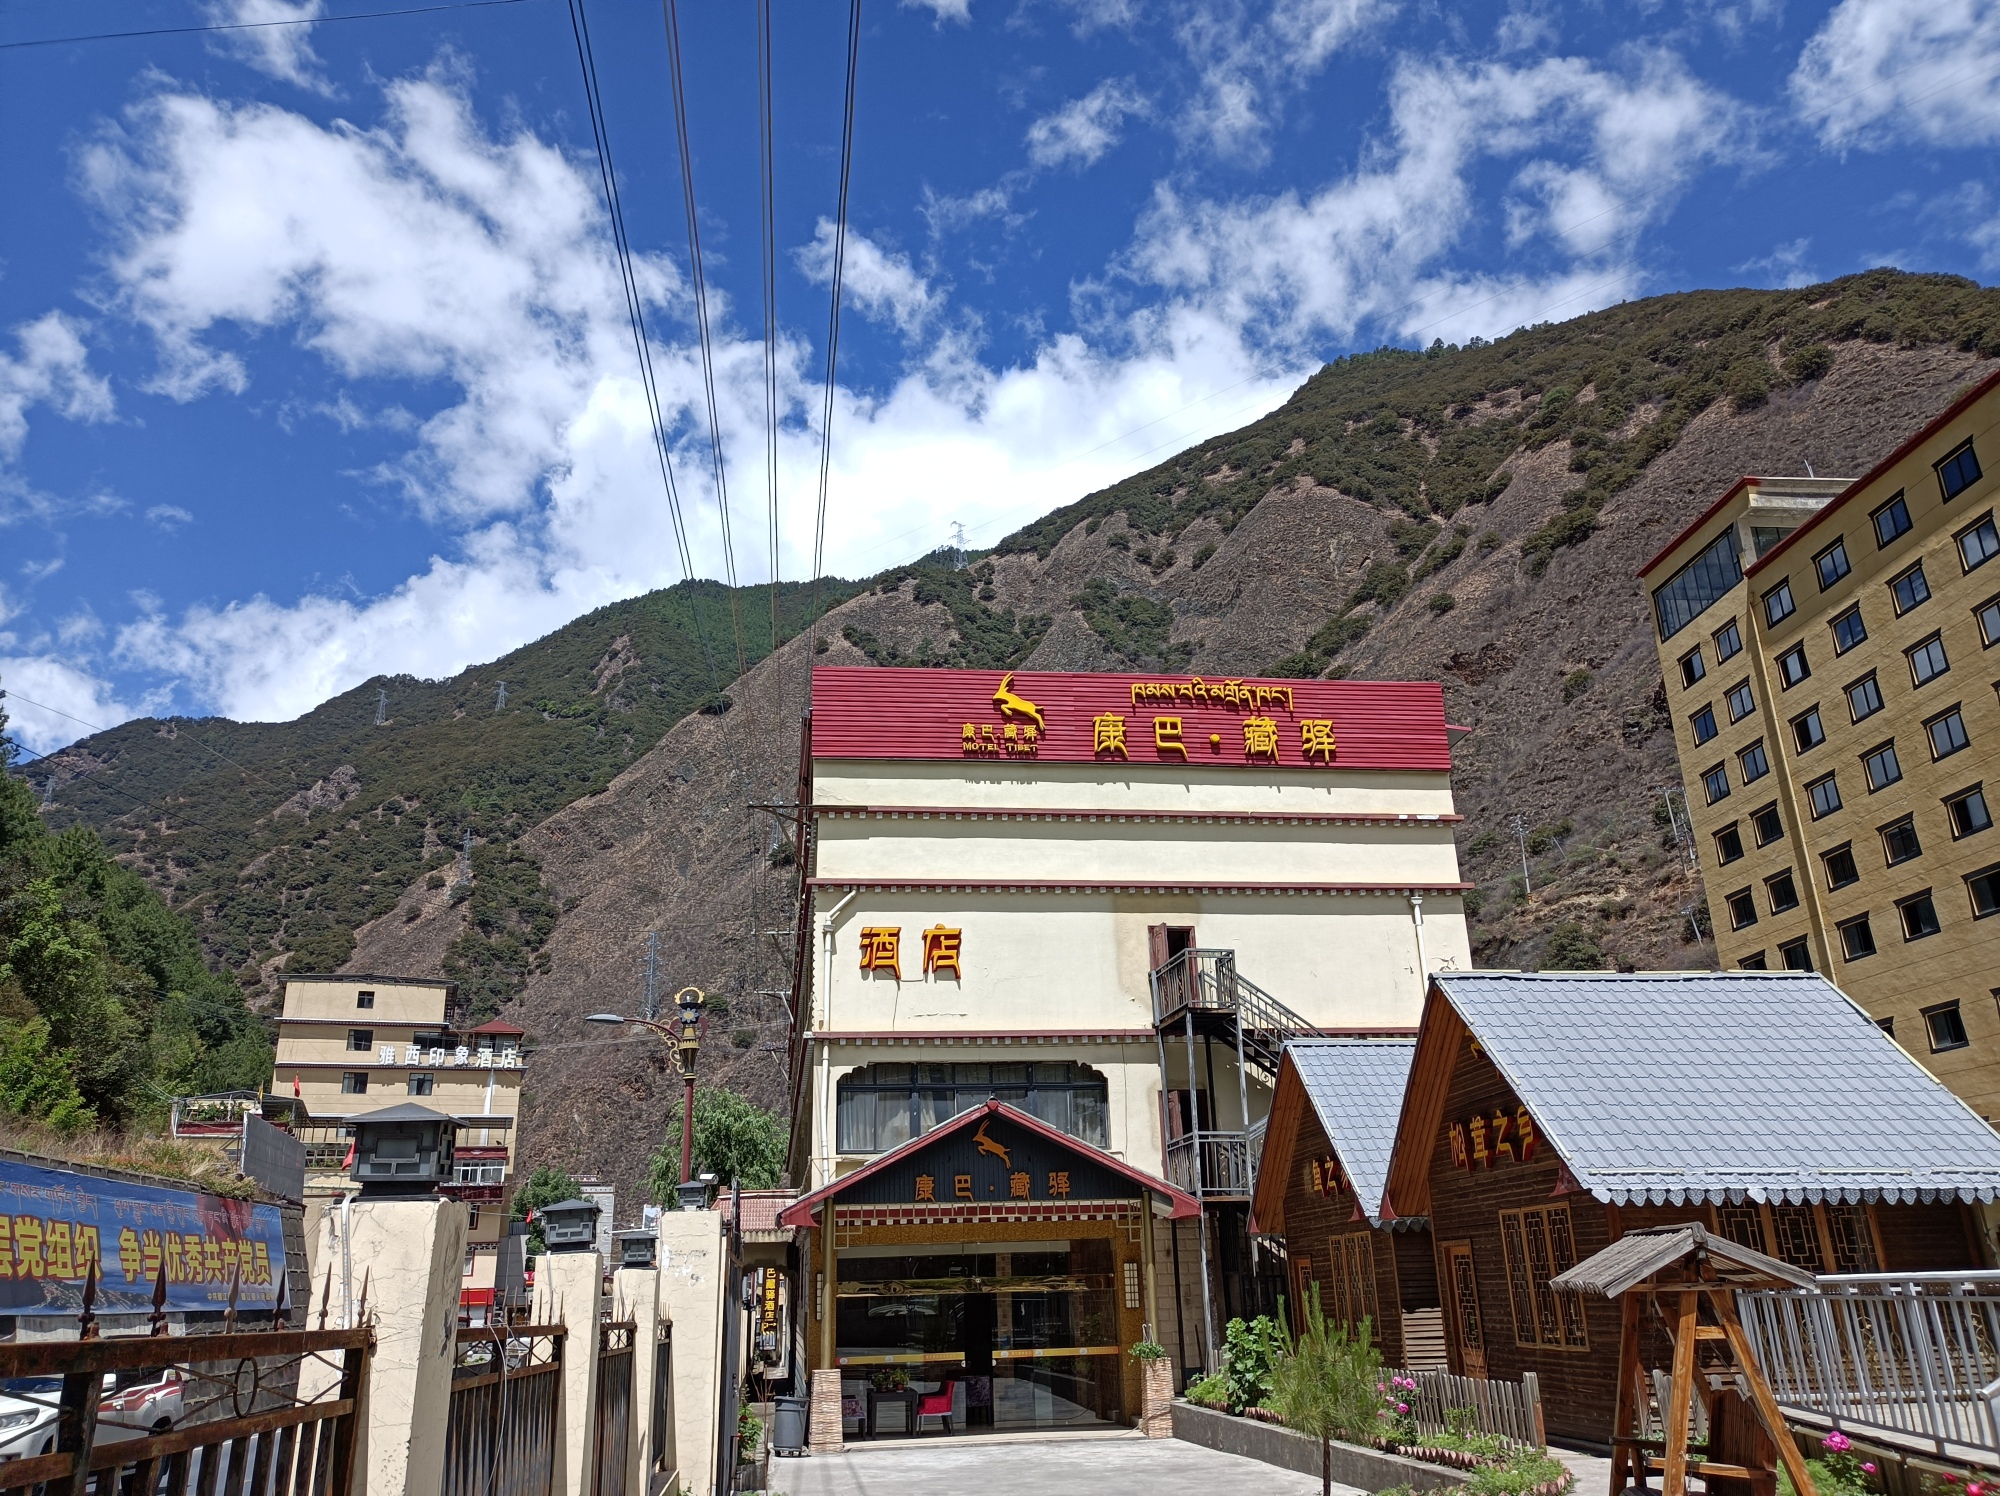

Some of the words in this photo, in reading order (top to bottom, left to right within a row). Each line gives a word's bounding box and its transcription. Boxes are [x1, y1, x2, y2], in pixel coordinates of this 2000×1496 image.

[963, 741, 1000, 751] MOTEL
[1005, 743, 1038, 752] TIBET
[859, 923, 962, 979] 酒店
[379, 1045, 518, 1069] 雅西印象酒店
[118, 1226, 272, 1286] 争当优秀共产党员
